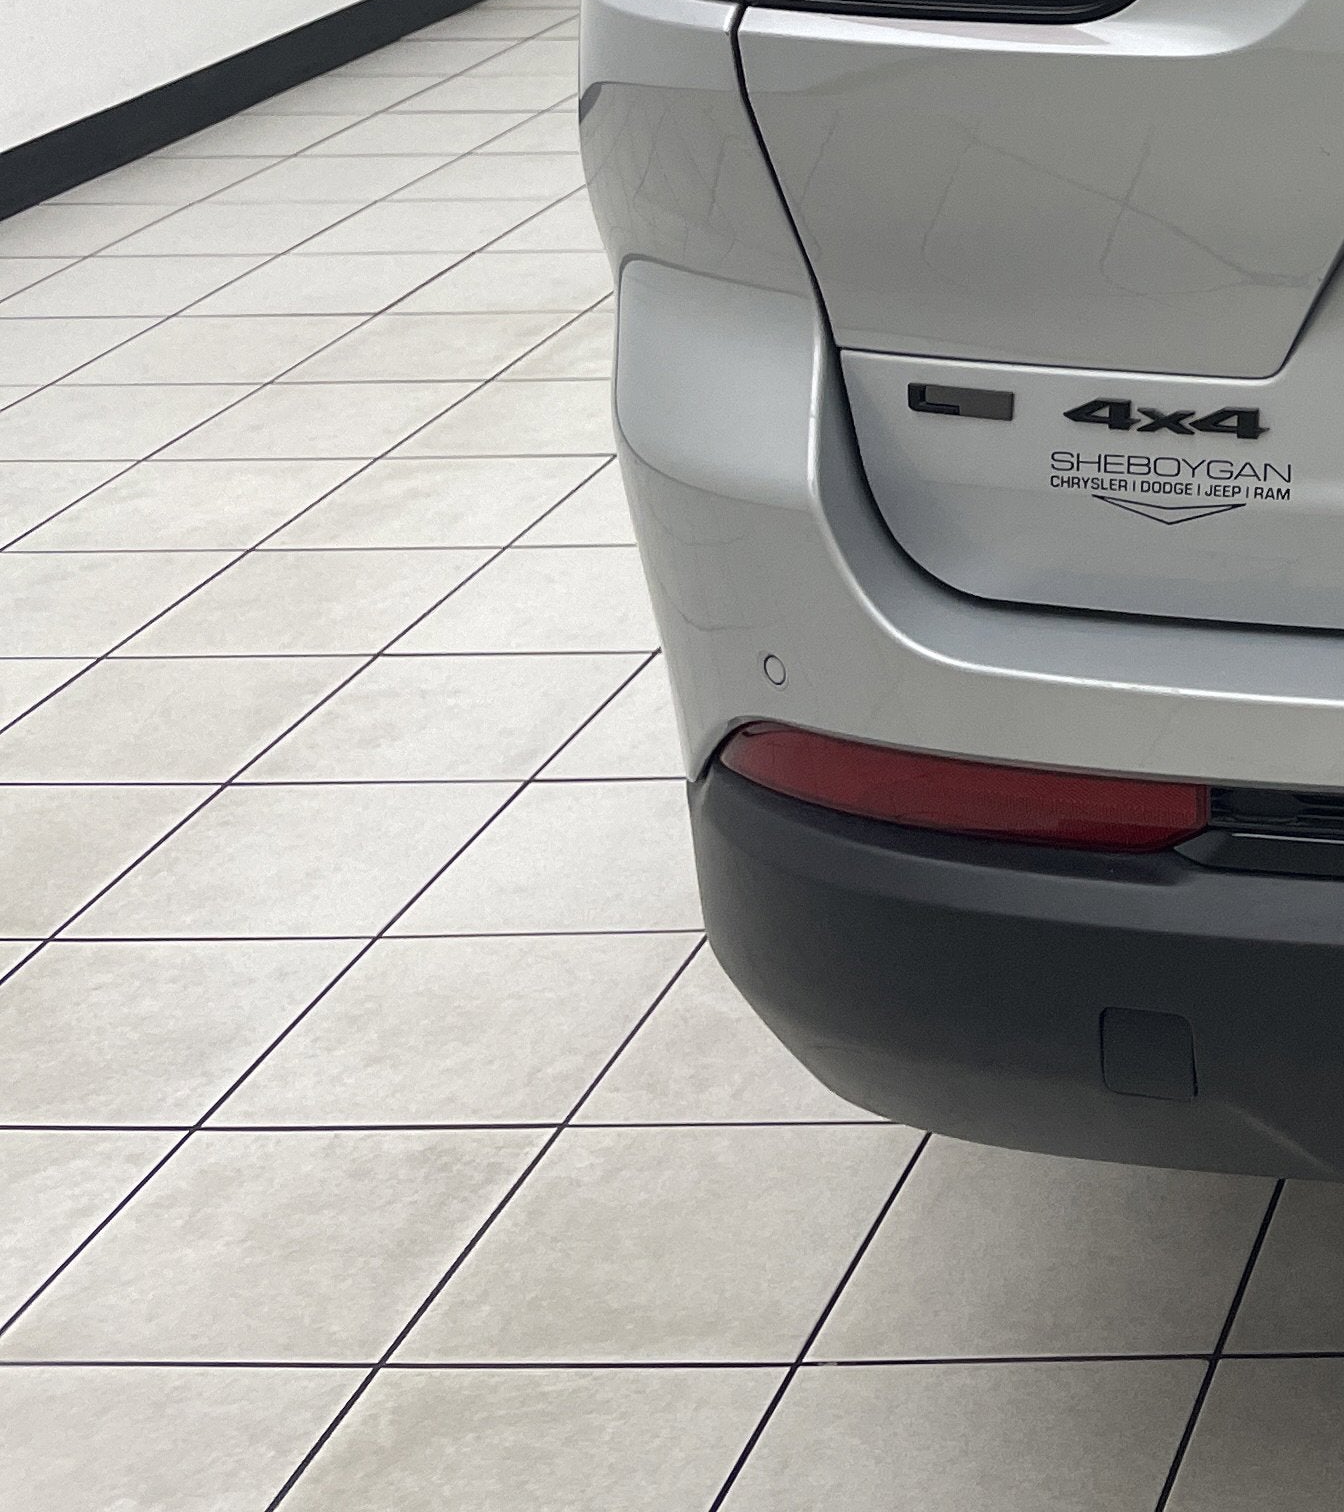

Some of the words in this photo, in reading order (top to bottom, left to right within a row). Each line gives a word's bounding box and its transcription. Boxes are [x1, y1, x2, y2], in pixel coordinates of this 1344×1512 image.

[1063, 397, 1271, 440] 4x4
[1050, 451, 1292, 483] SHEBOYGAN
[1050, 475, 1128, 492] CHRYSLER
[1141, 479, 1189, 495] DODGE
[1204, 482, 1241, 498] JEEP
[1253, 485, 1291, 501] RAM
